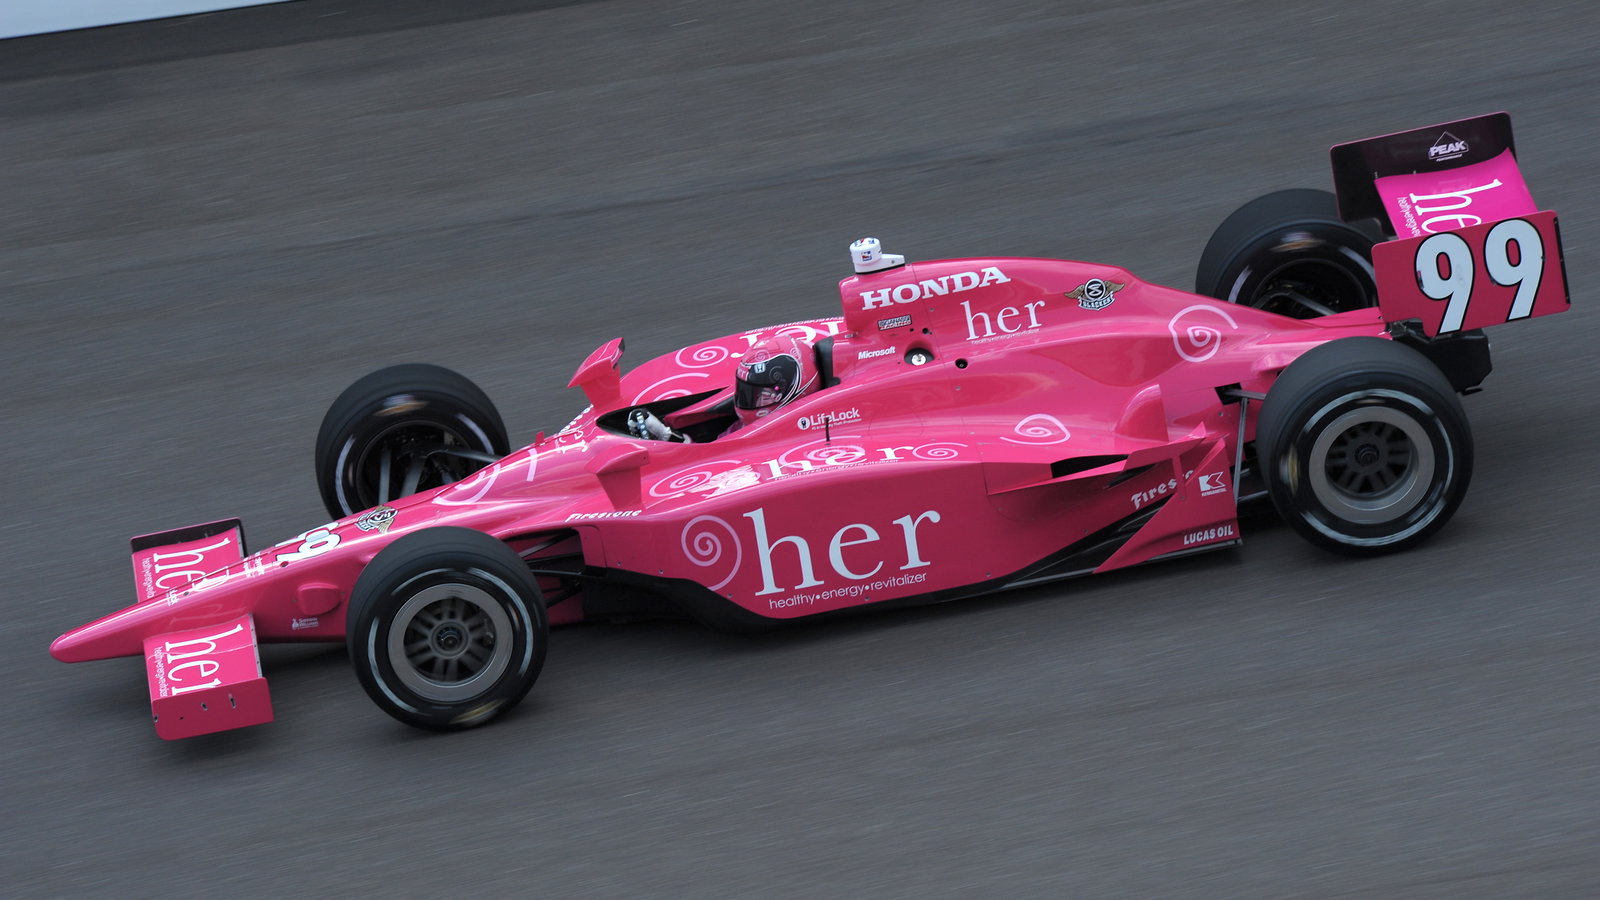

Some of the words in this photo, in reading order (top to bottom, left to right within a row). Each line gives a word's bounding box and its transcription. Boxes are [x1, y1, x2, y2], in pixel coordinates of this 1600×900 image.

[1429, 140, 1466, 156] PEAK
[1409, 178, 1503, 233] he
[860, 266, 1012, 311] HONDA
[1414, 217, 1546, 336] 99
[960, 300, 1046, 341] her
[858, 346, 896, 360] Microsoft
[760, 445, 914, 480] her
[1131, 470, 1194, 510] Fires
[564, 509, 643, 523] Firestone
[1183, 528, 1216, 545] LUCAS
[1217, 525, 1233, 538] OIL
[152, 537, 231, 590] he
[743, 507, 941, 596] her
[769, 592, 815, 609] healthy
[821, 584, 865, 600] energy
[870, 572, 927, 591] revitalizer
[165, 624, 244, 696] her
